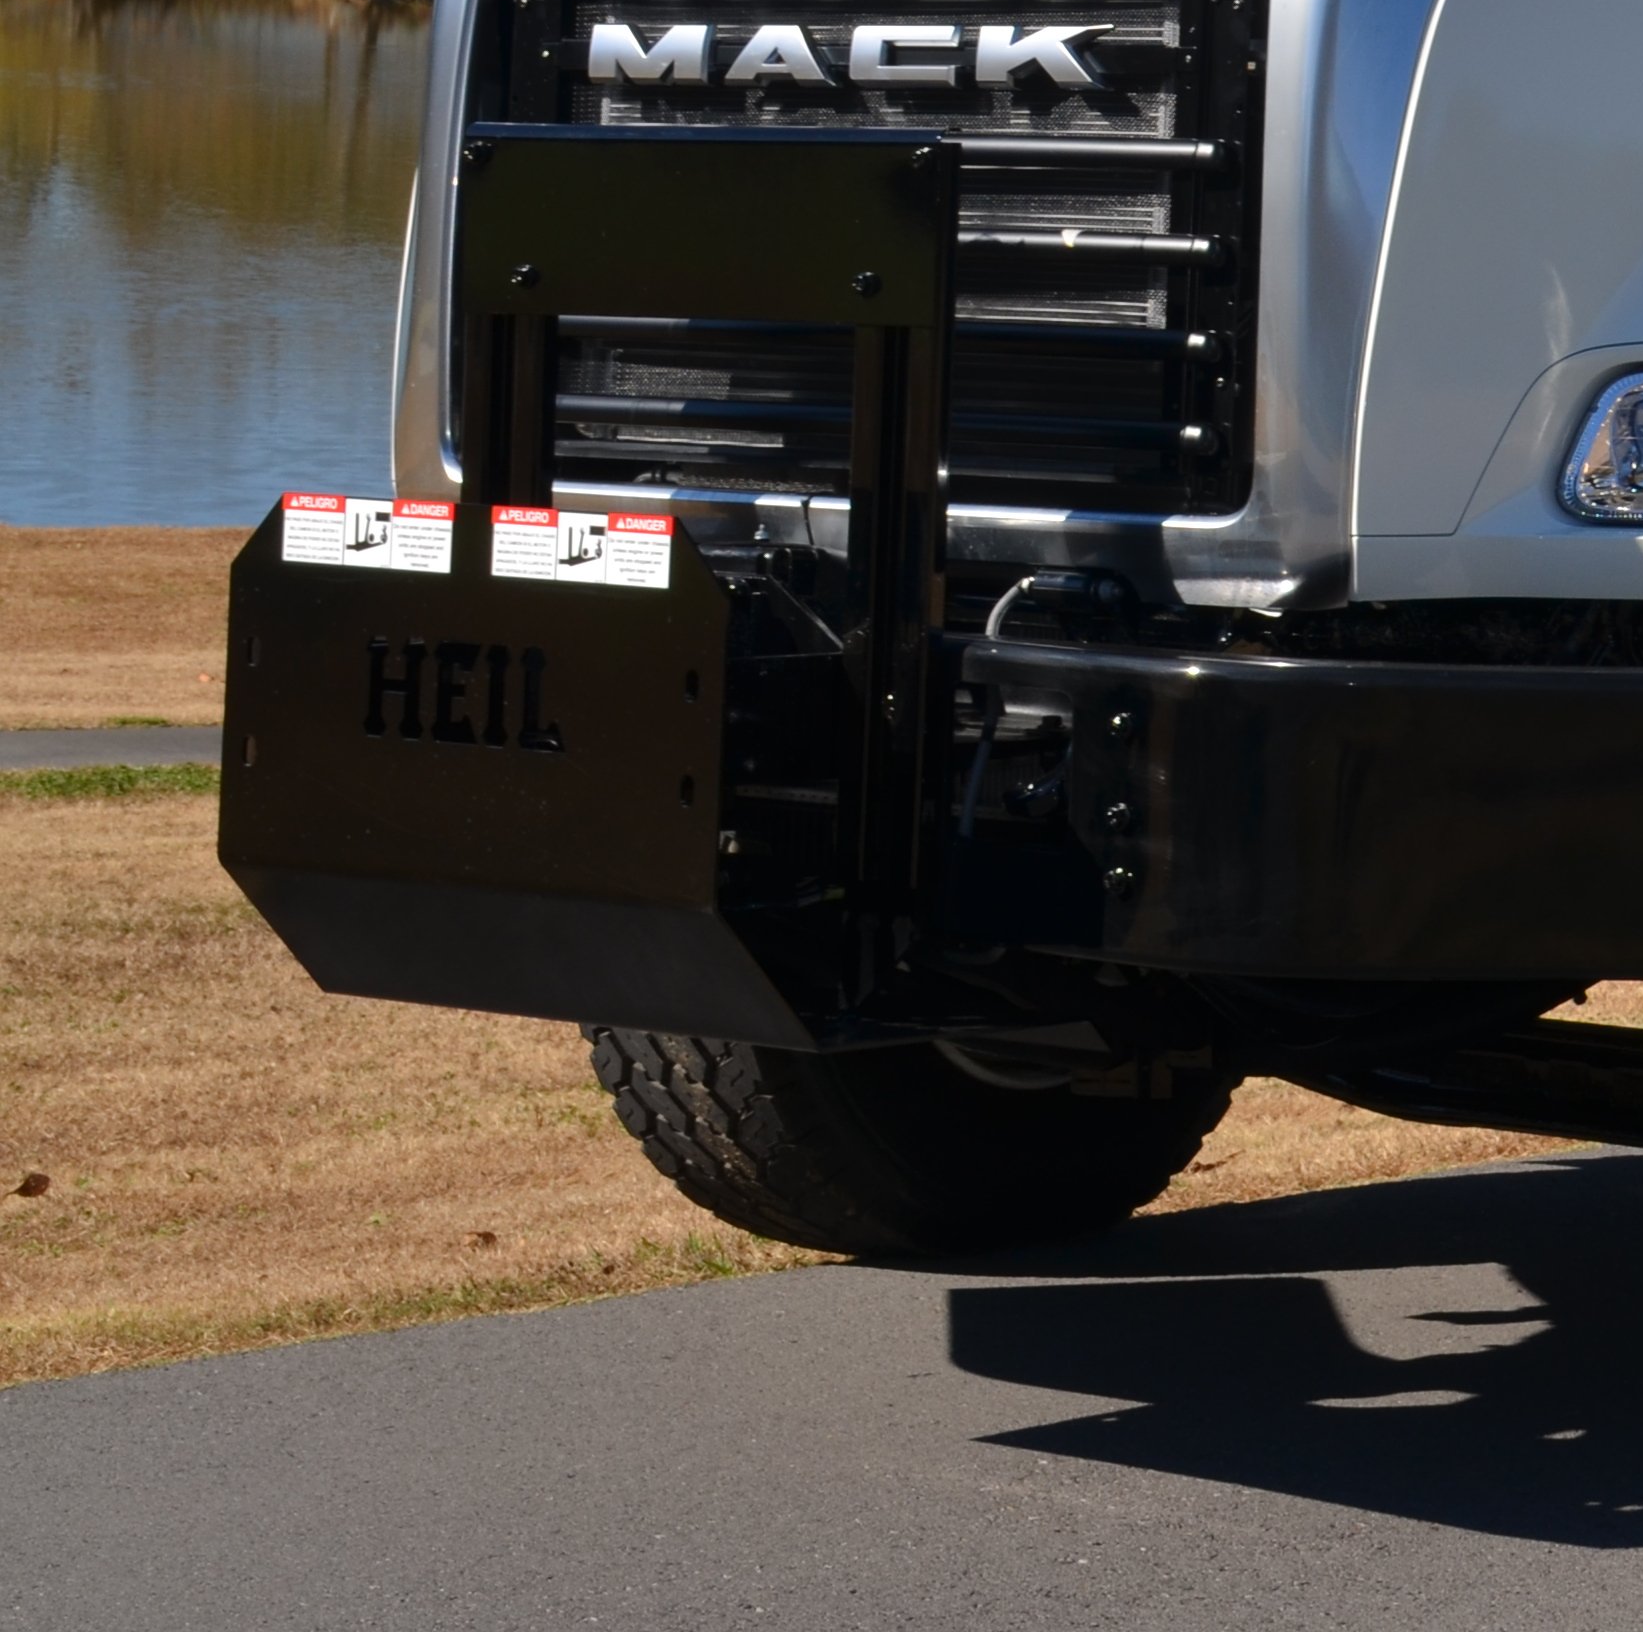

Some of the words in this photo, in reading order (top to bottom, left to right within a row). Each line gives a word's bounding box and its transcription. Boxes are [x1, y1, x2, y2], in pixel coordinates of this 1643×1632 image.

[587, 23, 1115, 90] MACK
[298, 495, 338, 509] PELIGRO
[410, 504, 449, 517] DANGER
[507, 510, 549, 524] PELIGRO
[625, 519, 666, 531] DANGER
[364, 635, 566, 753] HEIL
